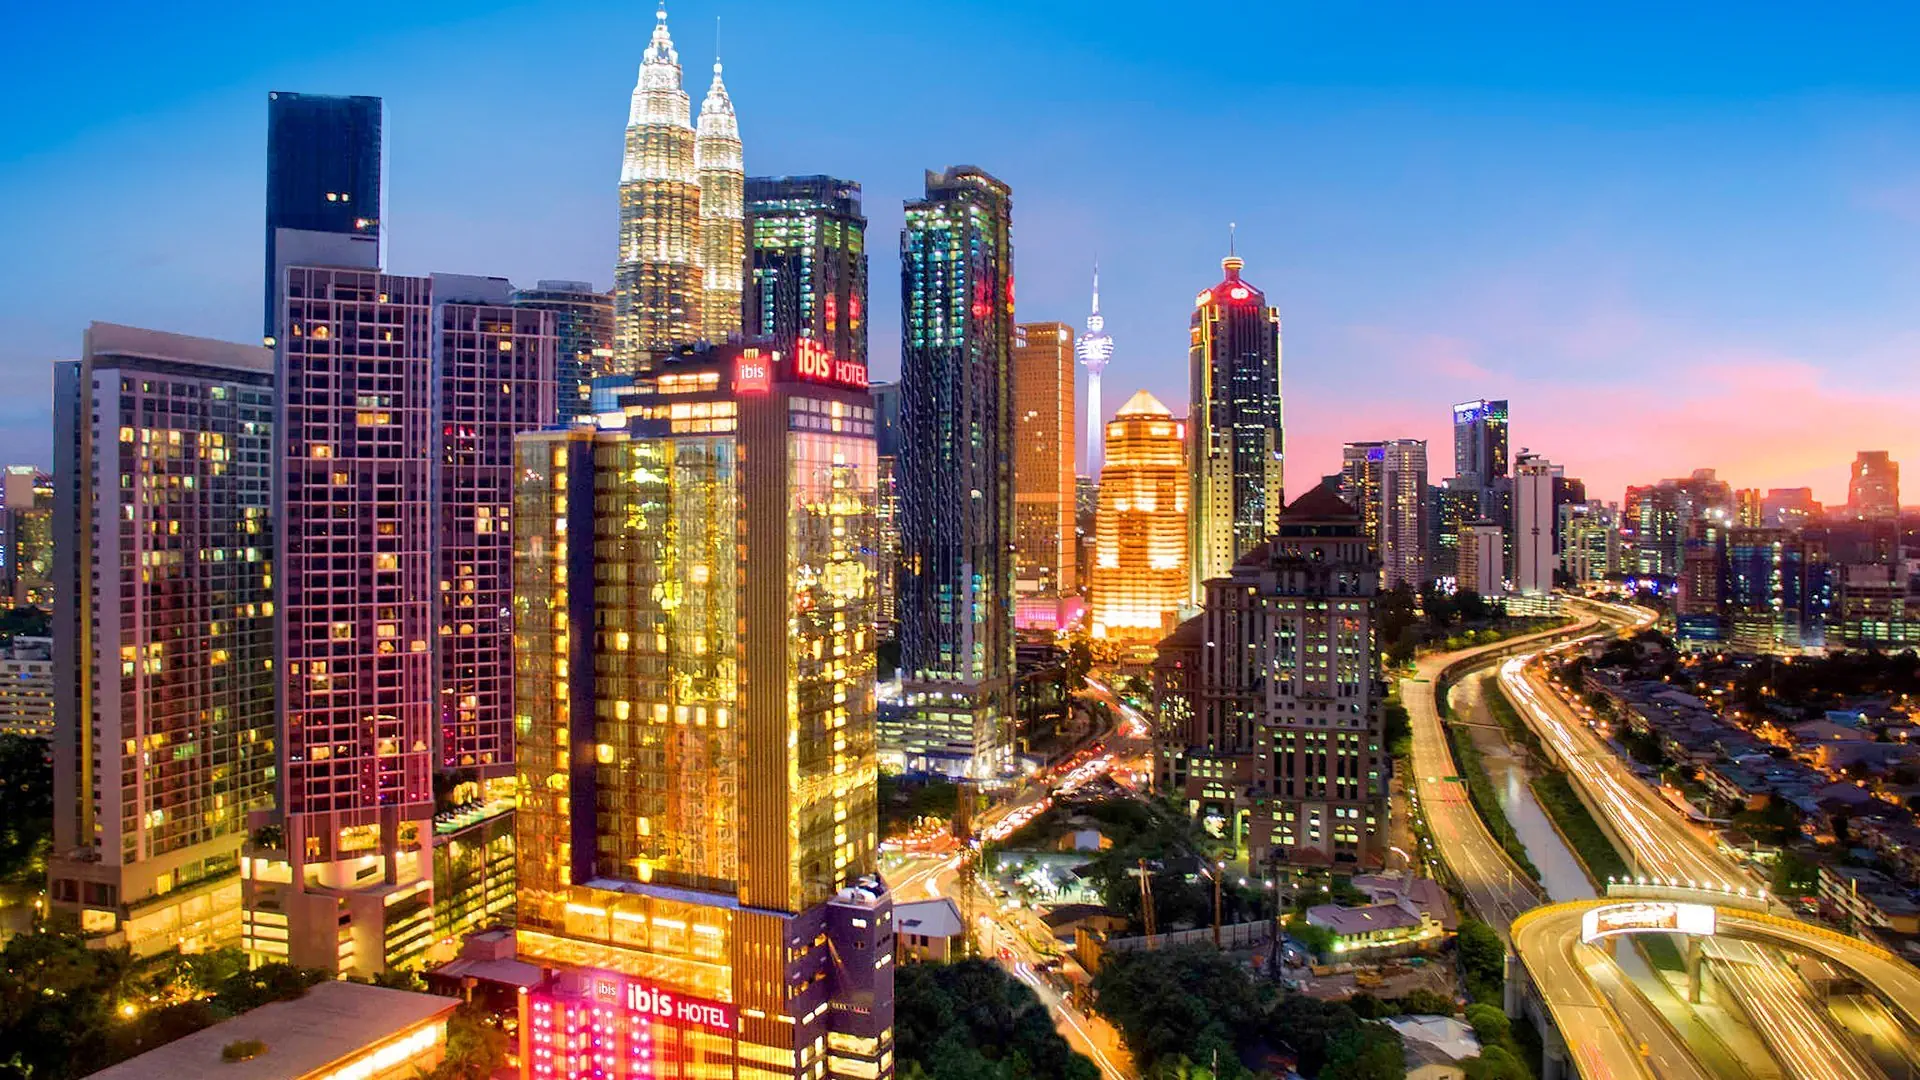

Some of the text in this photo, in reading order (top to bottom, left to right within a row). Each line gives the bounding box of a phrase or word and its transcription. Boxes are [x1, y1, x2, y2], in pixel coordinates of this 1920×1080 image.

[741, 364, 765, 379] ibis
[797, 339, 868, 386] ibis HOTEL
[598, 982, 616, 996] ibis
[627, 983, 730, 1029] ibis HOTEL
